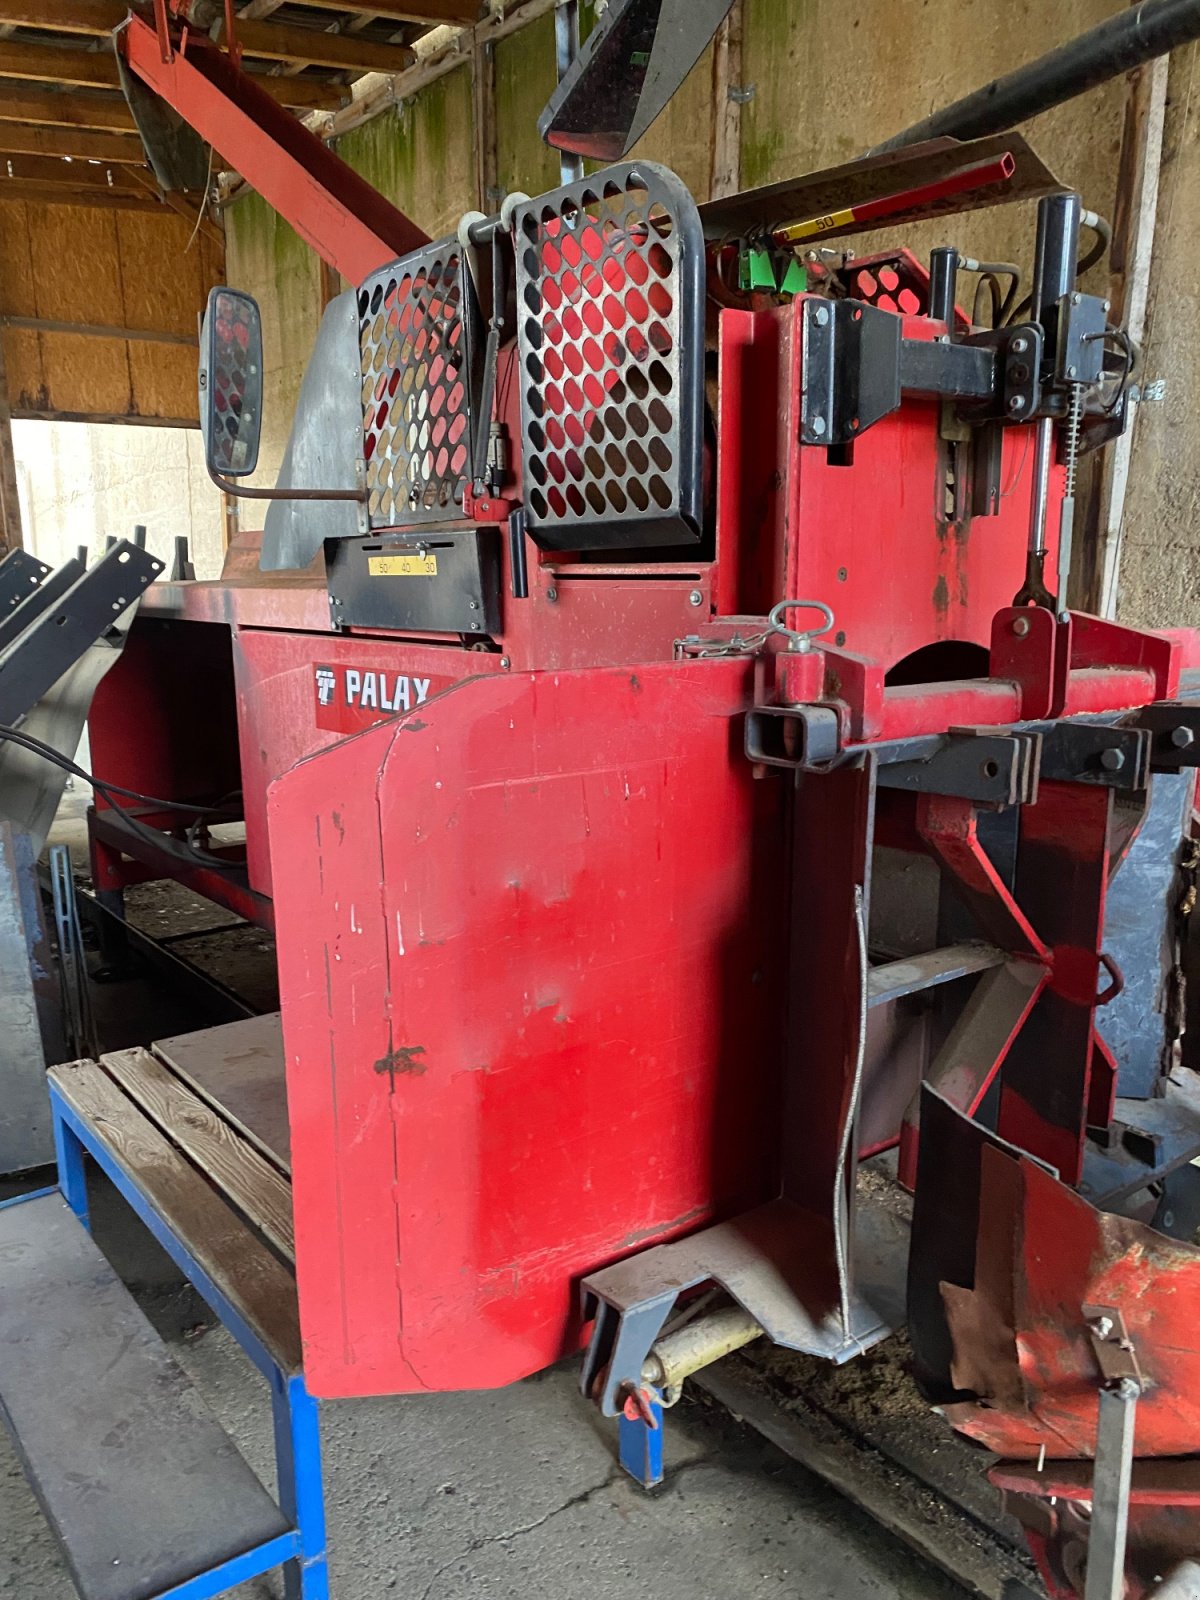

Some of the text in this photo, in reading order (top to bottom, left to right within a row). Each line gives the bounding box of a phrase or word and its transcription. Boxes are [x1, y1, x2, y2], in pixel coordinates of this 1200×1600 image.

[815, 216, 834, 230] 50
[379, 562, 435, 573] 50 40 30
